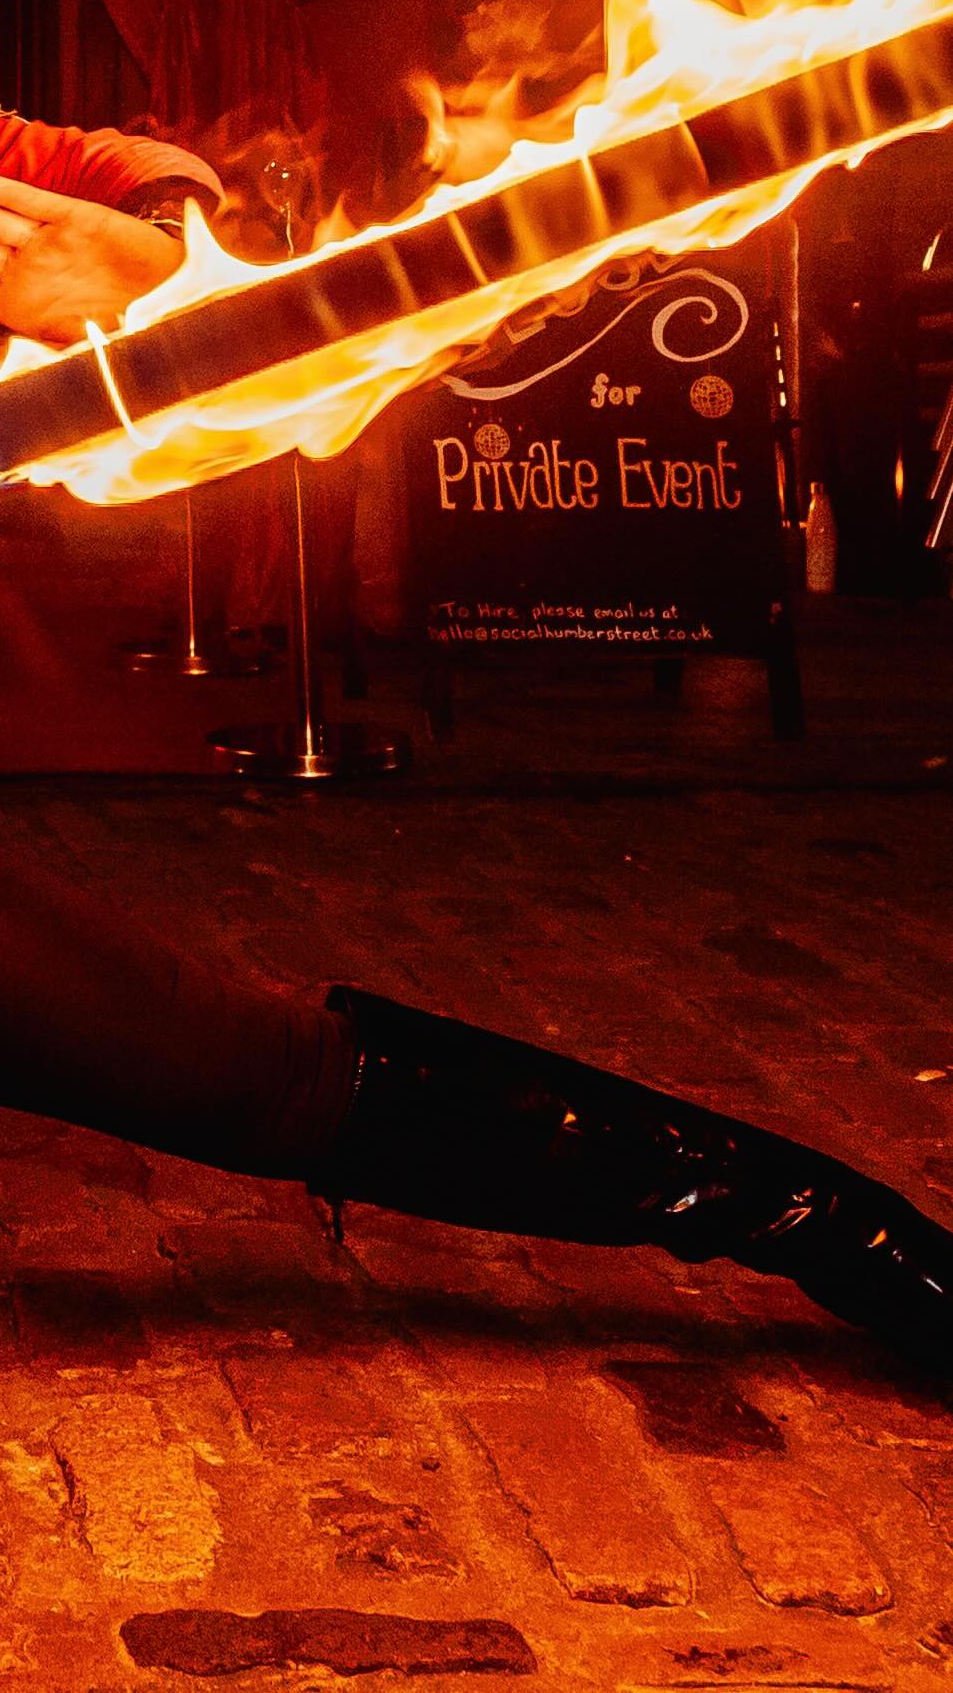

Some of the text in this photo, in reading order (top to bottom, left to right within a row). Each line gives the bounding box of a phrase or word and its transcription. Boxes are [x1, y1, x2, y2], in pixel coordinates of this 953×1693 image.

[590, 372, 642, 409] for
[433, 437, 742, 511] Private Event
[438, 600, 470, 619] To
[531, 602, 585, 620] please
[593, 602, 634, 619] email
[638, 607, 656, 619] us
[662, 604, 680, 619] at
